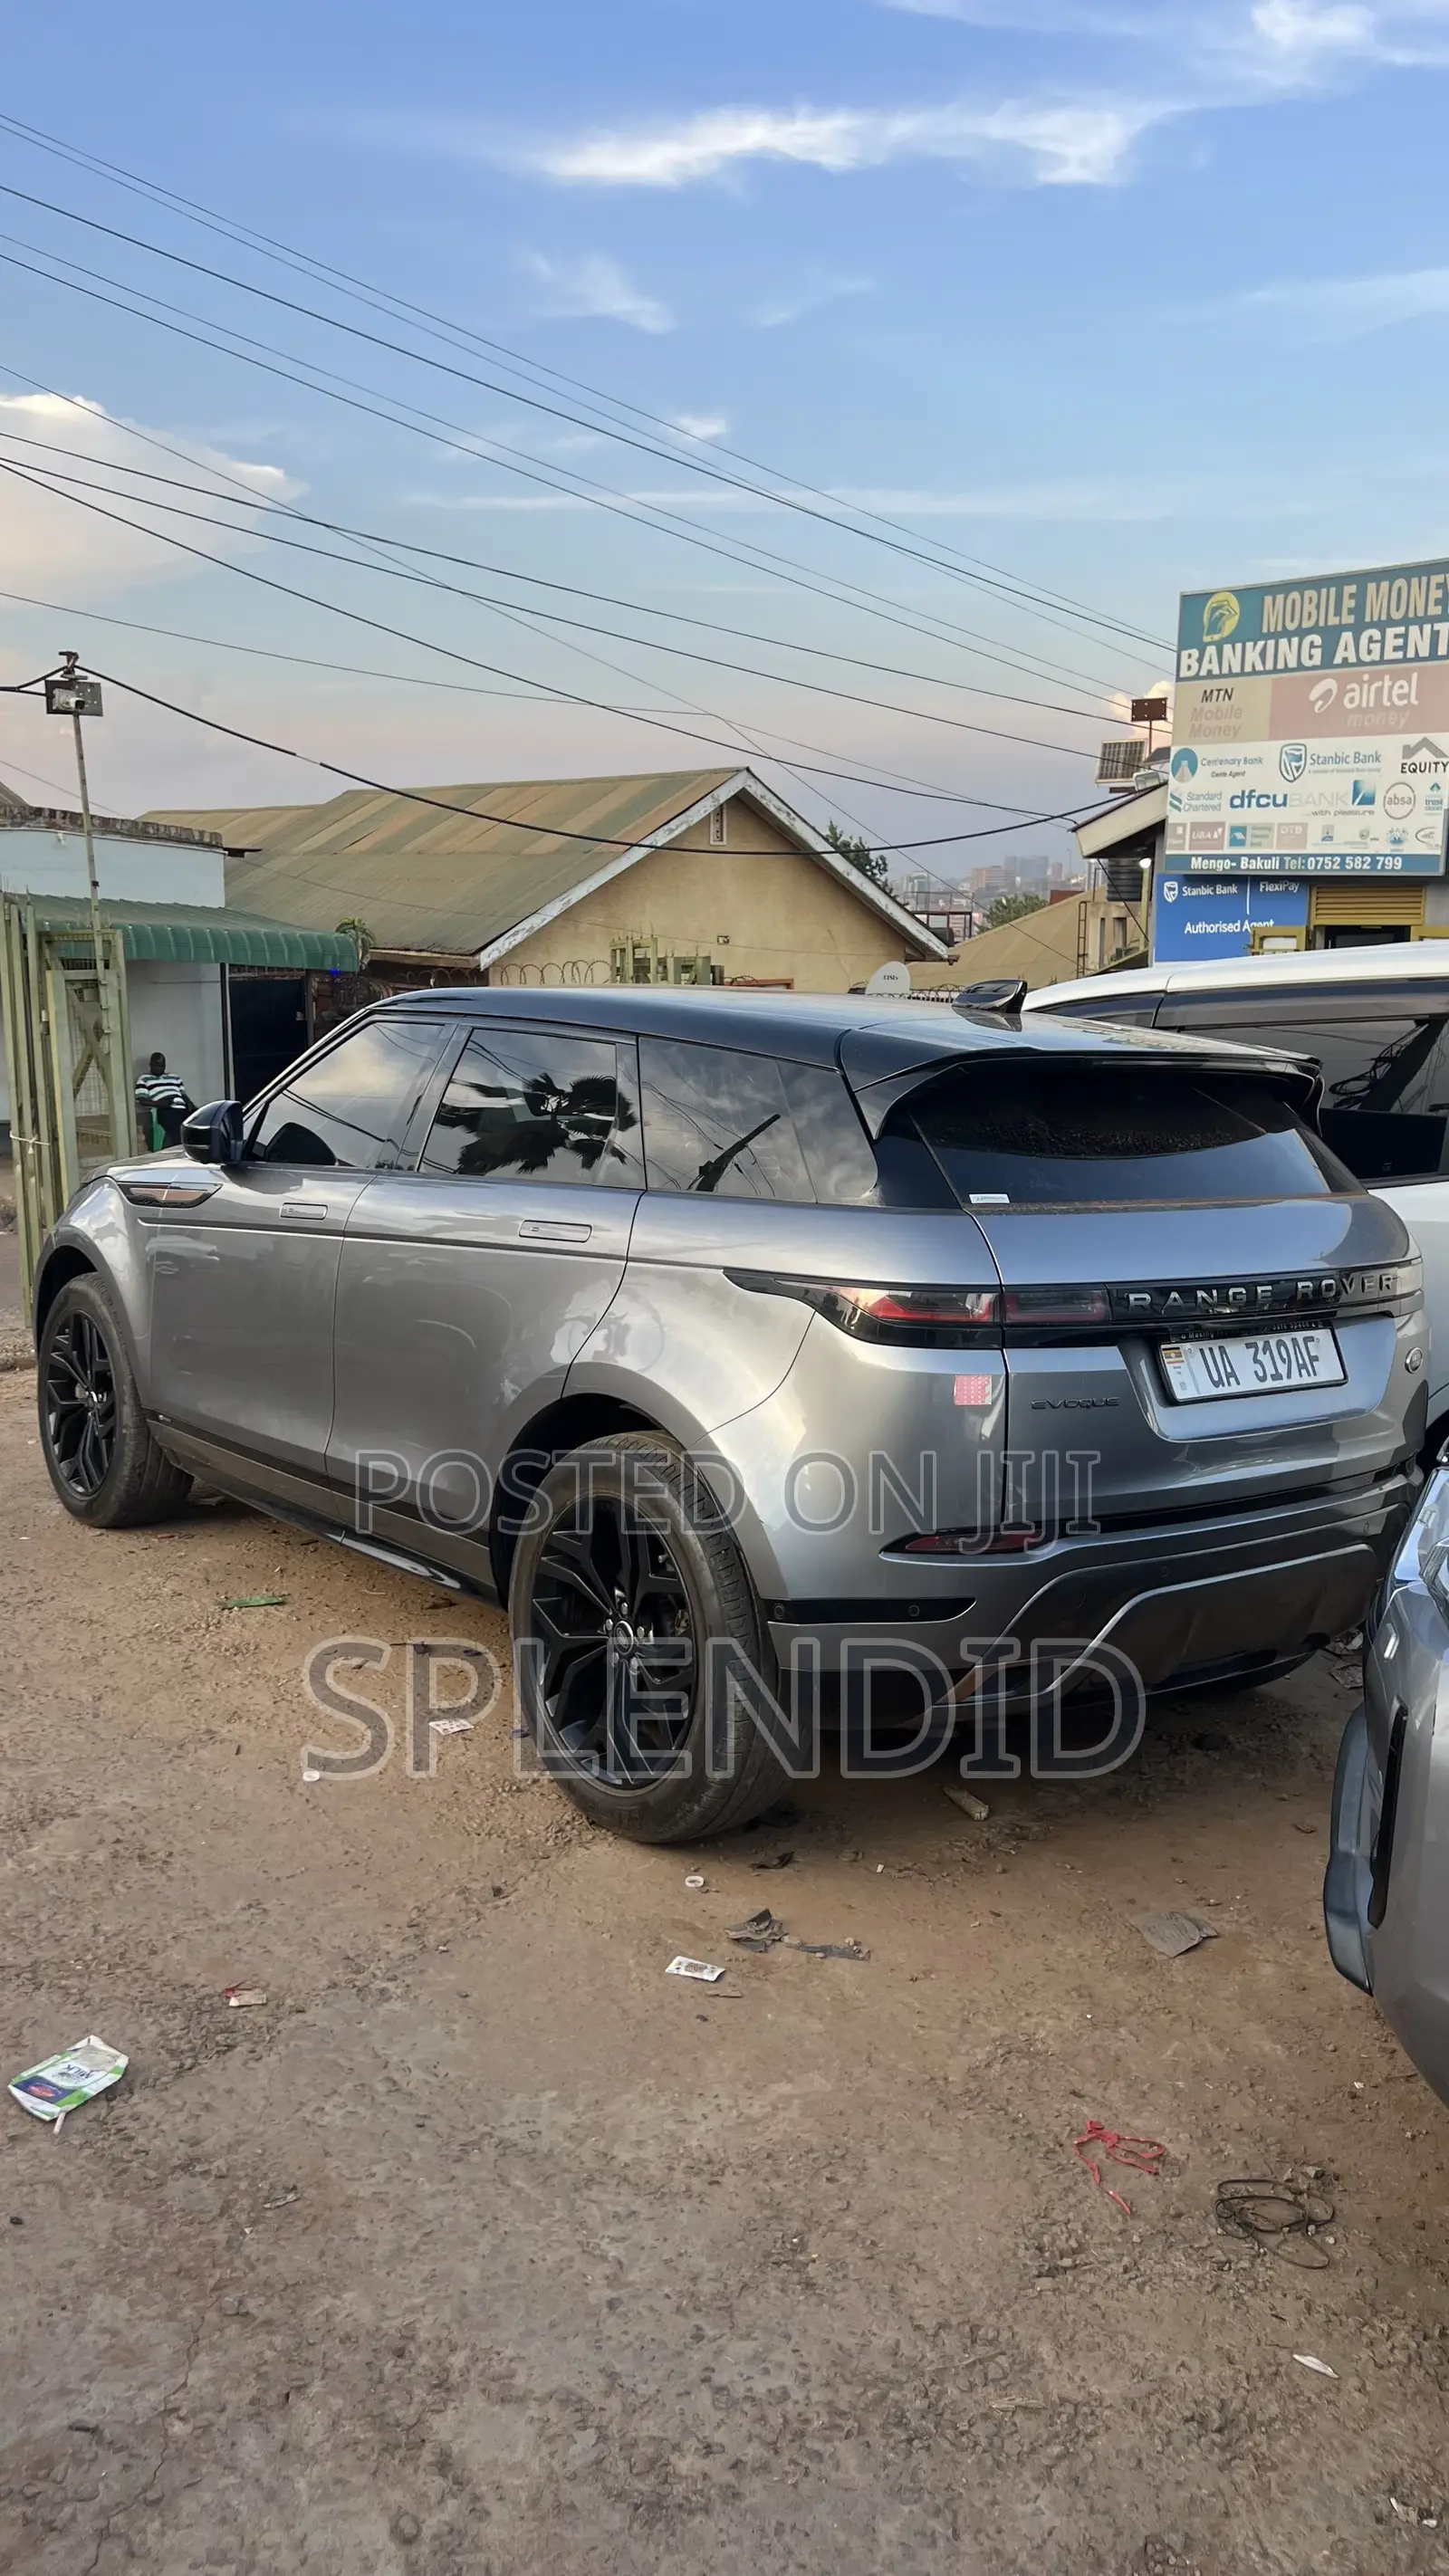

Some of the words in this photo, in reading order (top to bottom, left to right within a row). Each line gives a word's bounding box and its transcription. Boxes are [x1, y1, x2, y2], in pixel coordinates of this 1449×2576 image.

[1262, 584, 1357, 633] MOBILE
[1180, 634, 1322, 678] BANKING
[1333, 621, 1449, 664] AGENT
[1201, 687, 1234, 703] MTN
[1343, 672, 1419, 709] airtel
[1190, 704, 1243, 722] Mobile
[1347, 710, 1410, 729] money
[1188, 723, 1242, 739] Money
[1243, 756, 1263, 765] Bank
[1310, 752, 1350, 765] Stanbic
[1353, 751, 1382, 764] Bank
[1401, 761, 1449, 773] EQUITY
[1186, 791, 1223, 801] Standard
[1387, 793, 1412, 806] absa
[1183, 803, 1222, 812] Chartered
[1190, 857, 1236, 871] Mengo-
[1241, 856, 1280, 870] Bakuli
[1345, 857, 1371, 870] 582
[1376, 857, 1402, 870] 799
[1182, 884, 1214, 896] Stanbic
[1215, 883, 1238, 895] Bank
[1260, 880, 1300, 893] FlexiPay
[1185, 919, 1240, 934] Authorised
[1125, 1285, 1272, 1314] RANGE
[1296, 1274, 1393, 1301] ROVER
[1199, 1345, 1241, 1388] UA
[1245, 1336, 1319, 1383] 319AF
[1031, 1397, 1119, 1410] EVOQUE
[63, 2064, 94, 2079] MILK
